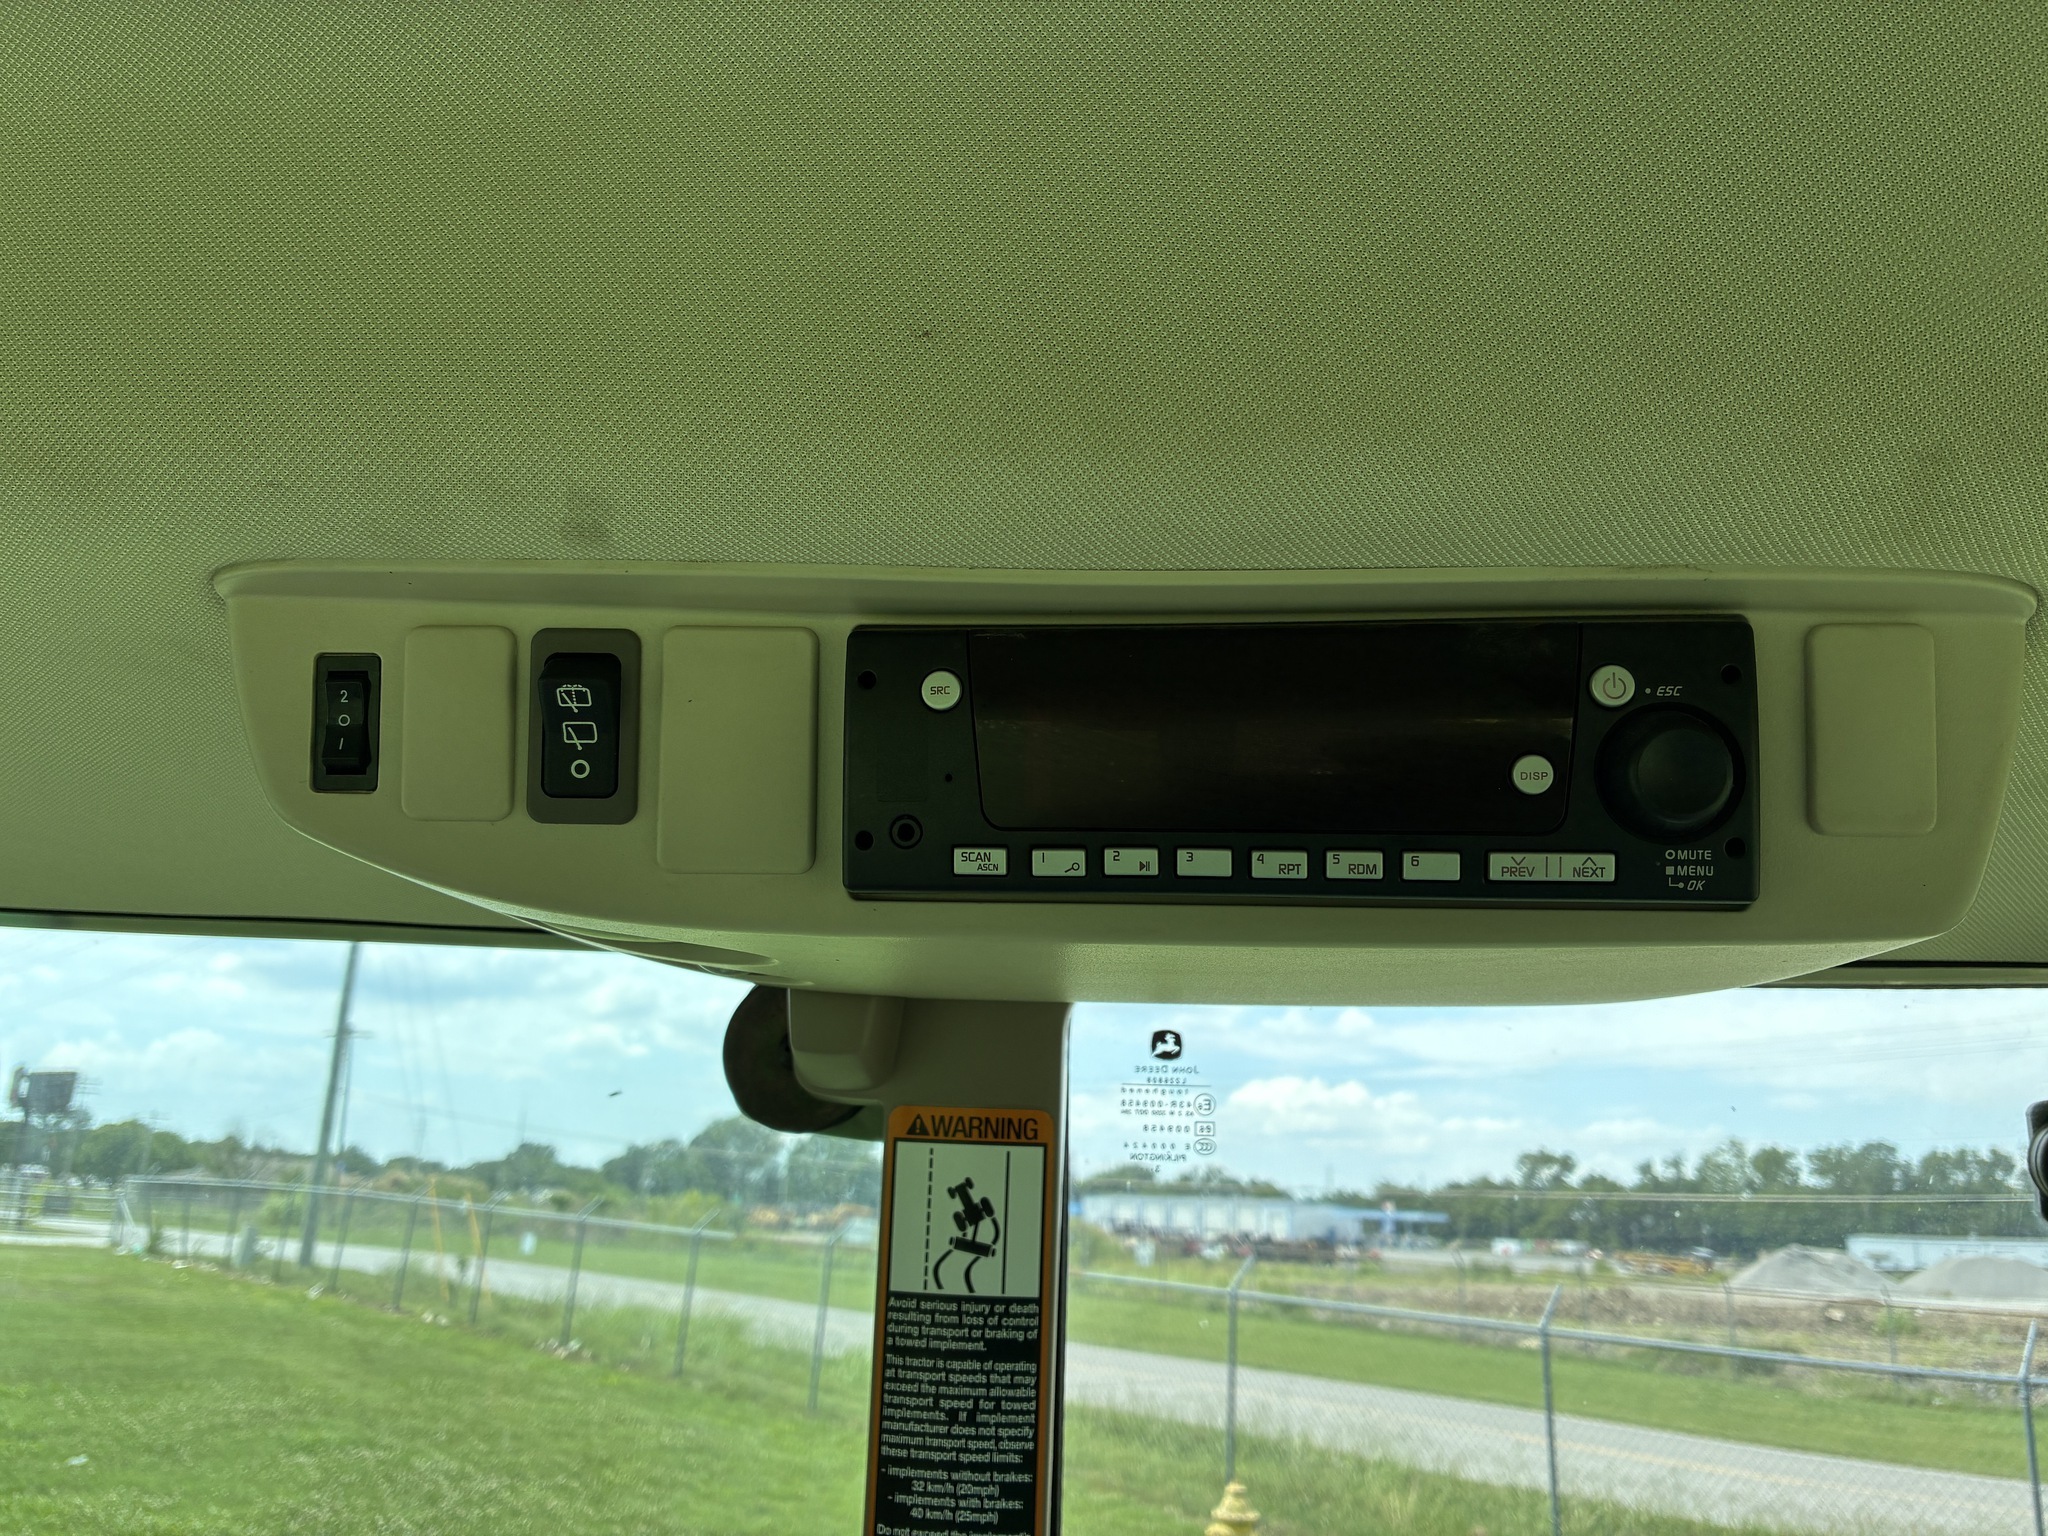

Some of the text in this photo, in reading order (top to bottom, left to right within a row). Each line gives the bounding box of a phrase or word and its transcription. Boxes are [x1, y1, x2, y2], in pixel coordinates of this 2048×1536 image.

[340, 690, 349, 703] 2
[930, 685, 951, 695] SRC
[1656, 685, 1683, 697] ESC
[1520, 771, 1549, 781] DISP
[960, 852, 992, 863] SCAN
[1112, 851, 1121, 862] 2
[1185, 852, 1194, 862] 3
[1256, 854, 1265, 864] 4
[1332, 854, 1341, 865] 5
[1410, 856, 1420, 867] 6
[1677, 849, 1712, 861] MUTE
[976, 863, 999, 872] ASCN
[1278, 863, 1302, 875] RPT
[1348, 863, 1378, 875] RDM
[1500, 865, 1536, 878] PREV
[1572, 866, 1606, 878] NEXT
[1677, 865, 1714, 877] MENU
[1686, 880, 1706, 891] OK
[931, 1115, 1038, 1140] WARNING
[888, 1298, 1039, 1314] Avoid serious injury or death
[888, 1311, 1038, 1327] resulting from loss of control
[887, 1323, 1038, 1341] during transport or braking of
[895, 1336, 927, 1347] towed
[929, 1338, 987, 1351] implement.
[886, 1354, 1037, 1373] This tractor is capable of operating
[885, 1368, 1037, 1387] at transport speeds that may
[884, 1382, 1037, 1398] exceed the maximum allowable
[883, 1394, 1036, 1411] transport speed for towed
[958, 1411, 968, 1422] If
[976, 1413, 1035, 1425] implement
[882, 1420, 1034, 1439] manufacturer does not specify
[881, 1433, 1034, 1451] maximum transport speed, observe
[881, 1445, 1023, 1464] these transport speed limits:
[888, 1464, 948, 1480] implements
[951, 1470, 991, 1482] without
[993, 1471, 1032, 1483] brakes:
[911, 1480, 999, 1498] 32 km/h (20mph)
[894, 1492, 956, 1508] implements
[958, 1497, 981, 1508] with
[983, 1498, 1023, 1510] brakes:
[910, 1508, 999, 1525] 40 km/h (25mph)
[877, 1523, 891, 1536] Do
[893, 1526, 910, 1536] not
